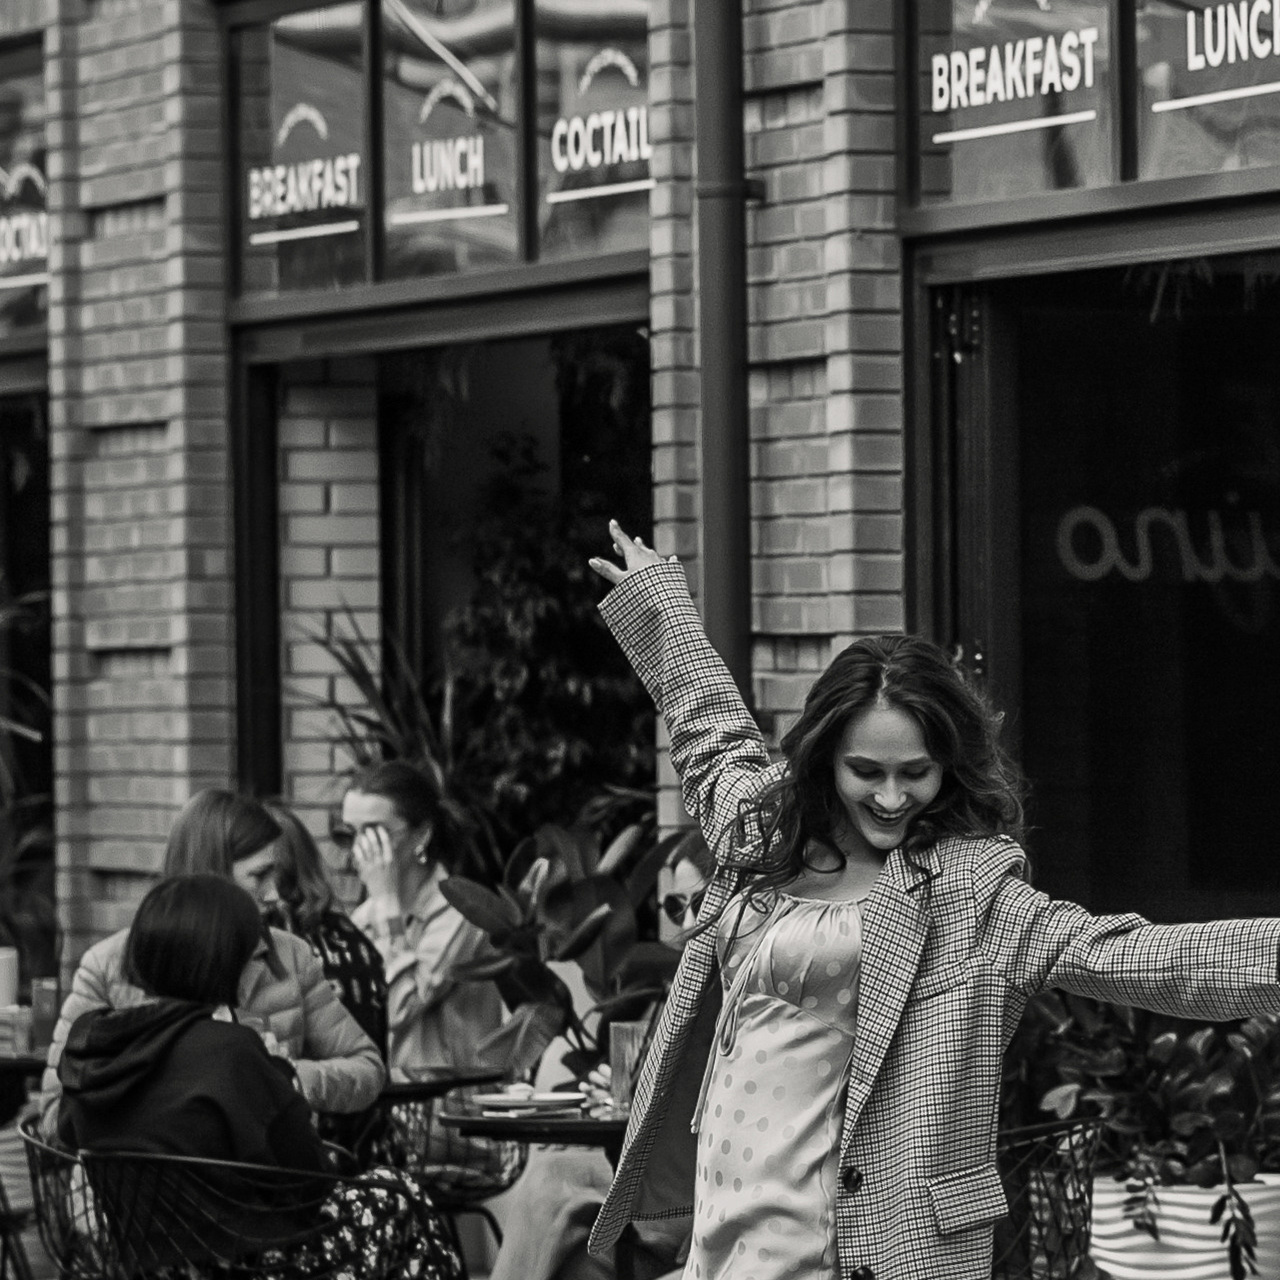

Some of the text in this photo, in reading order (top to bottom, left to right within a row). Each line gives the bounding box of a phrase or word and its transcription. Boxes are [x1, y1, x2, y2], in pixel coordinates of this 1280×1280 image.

[931, 27, 1098, 112] BREAKFAST
[248, 152, 360, 219] BREAKFAST
[411, 134, 484, 194] LUNCH
